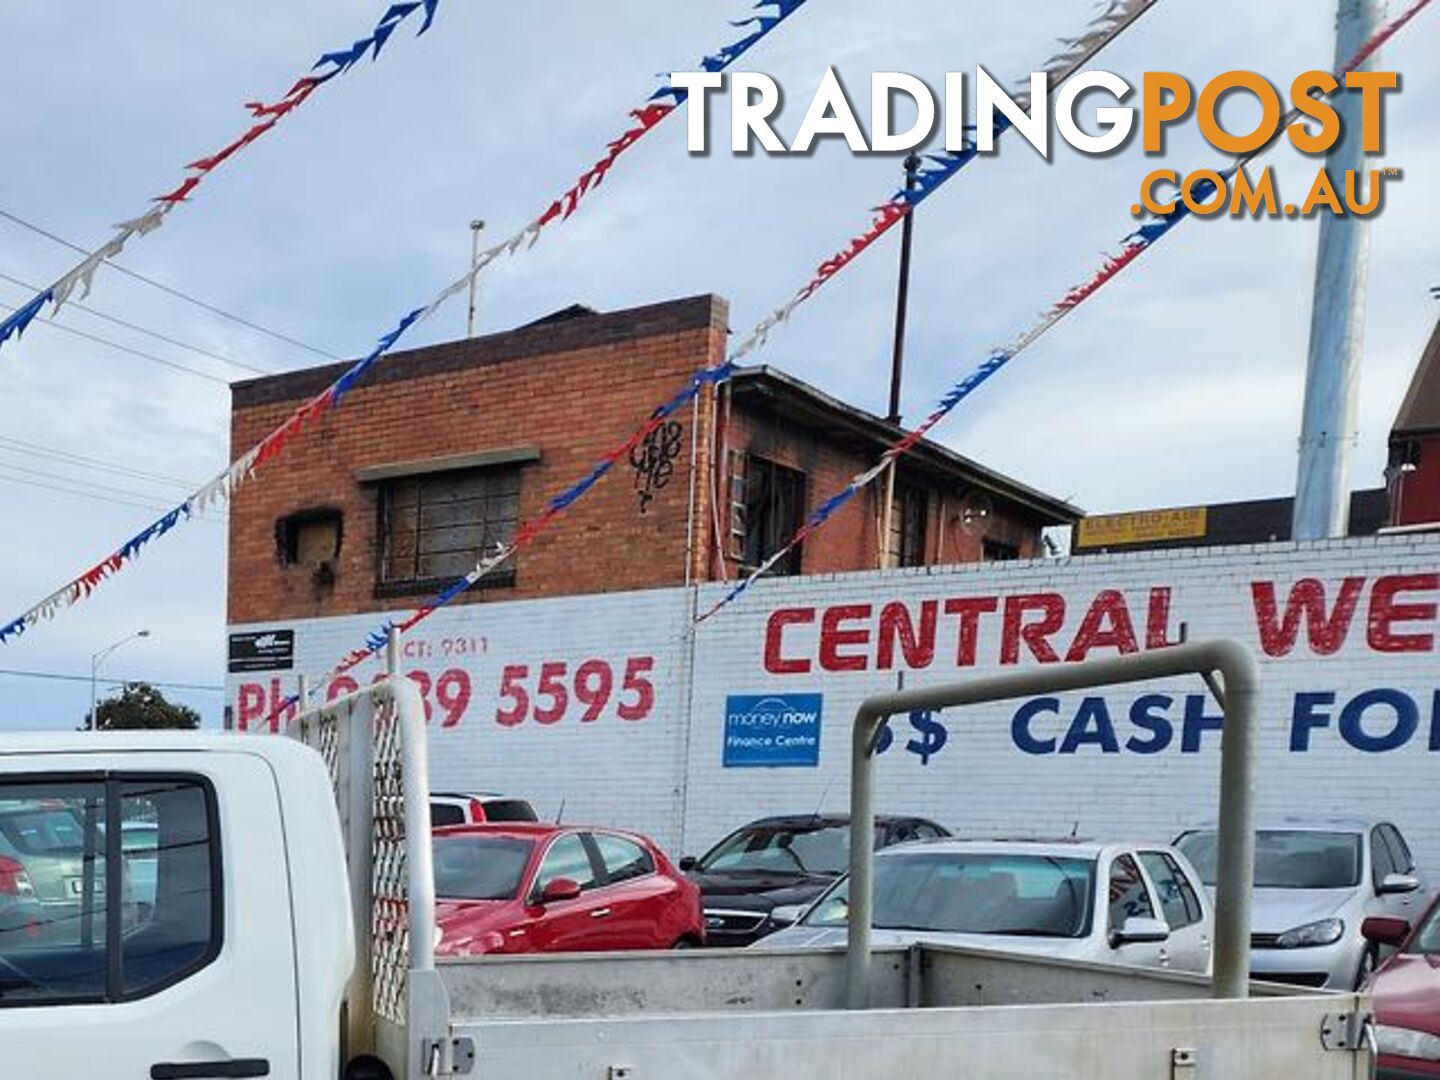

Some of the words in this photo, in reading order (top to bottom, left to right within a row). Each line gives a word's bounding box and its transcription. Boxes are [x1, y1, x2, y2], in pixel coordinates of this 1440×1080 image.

[441, 636, 488, 657] 9311
[763, 586, 1183, 674] CENTRAL
[495, 656, 656, 728] 5595
[782, 711, 818, 725] now
[1011, 694, 1225, 756] CASH
[1289, 687, 1440, 754] FO
[727, 735, 772, 748] Finance
[775, 734, 816, 747] Centre
